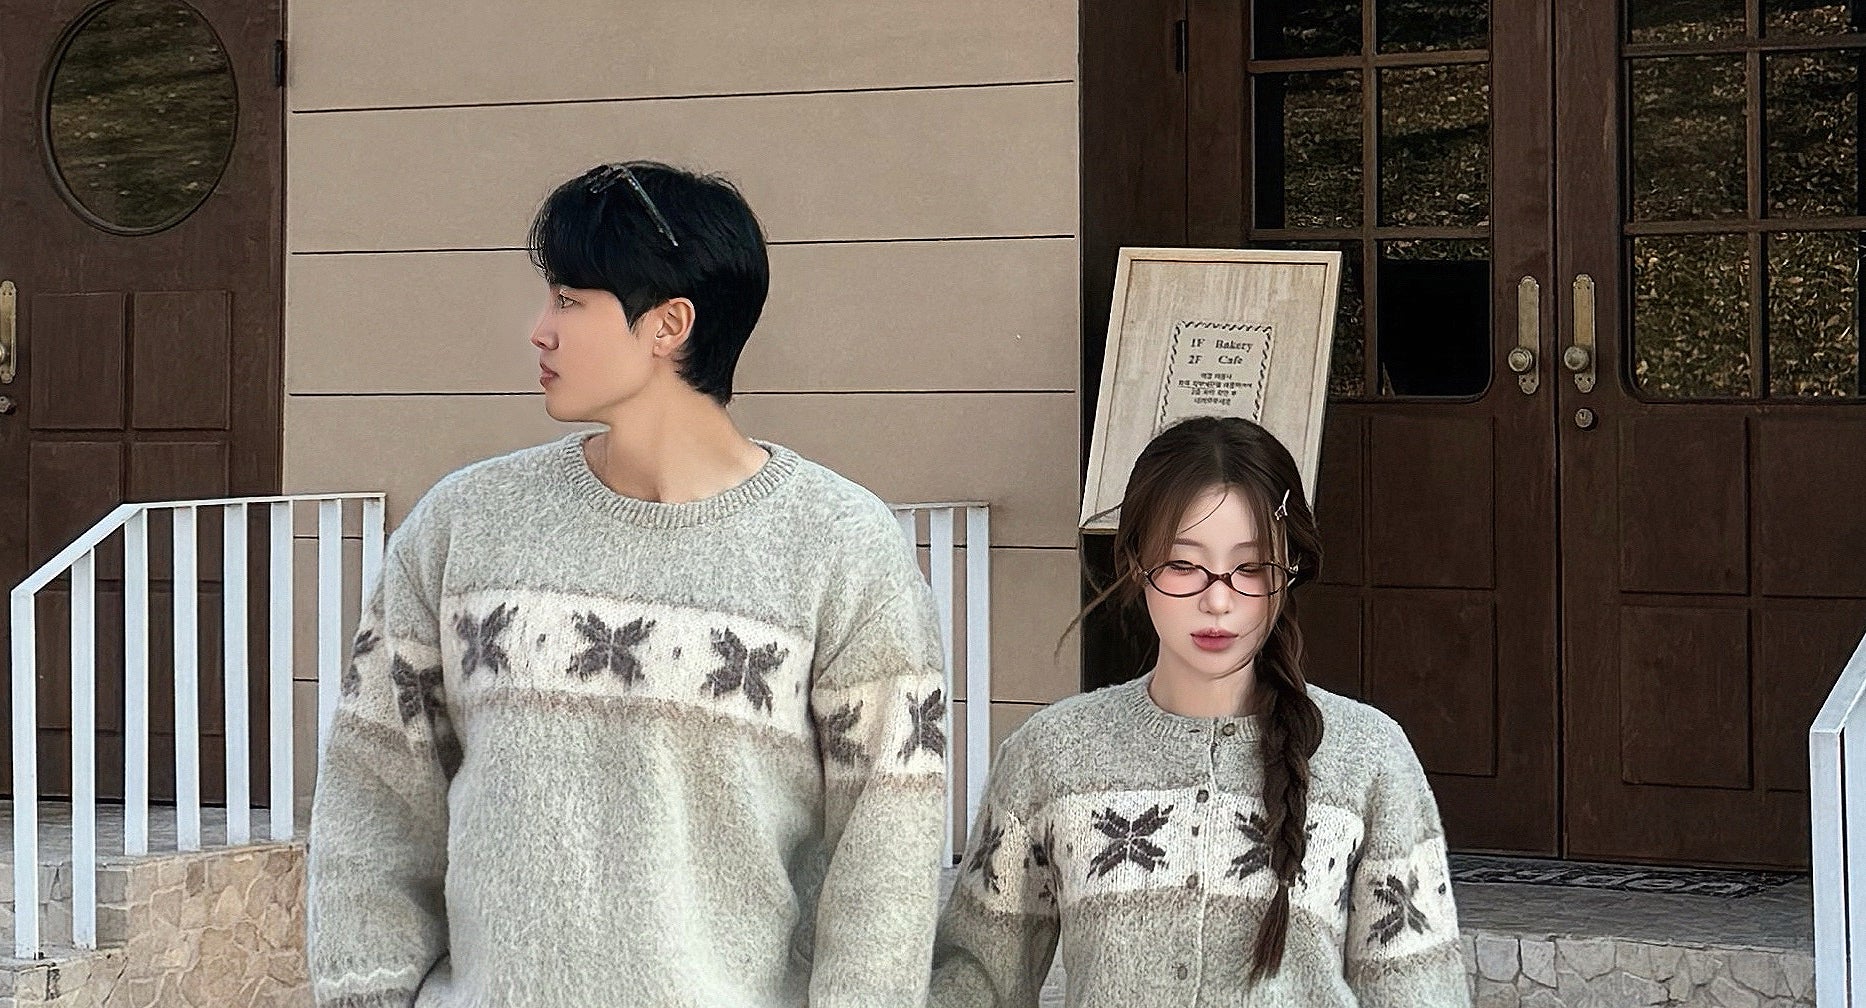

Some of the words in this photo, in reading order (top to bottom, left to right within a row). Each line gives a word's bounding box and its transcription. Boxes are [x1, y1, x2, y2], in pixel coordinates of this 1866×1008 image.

[1191, 338, 1205, 347] 1F
[1215, 339, 1253, 353] Bakery
[1188, 355, 1203, 364] 2F
[1218, 355, 1243, 364] Cafe
